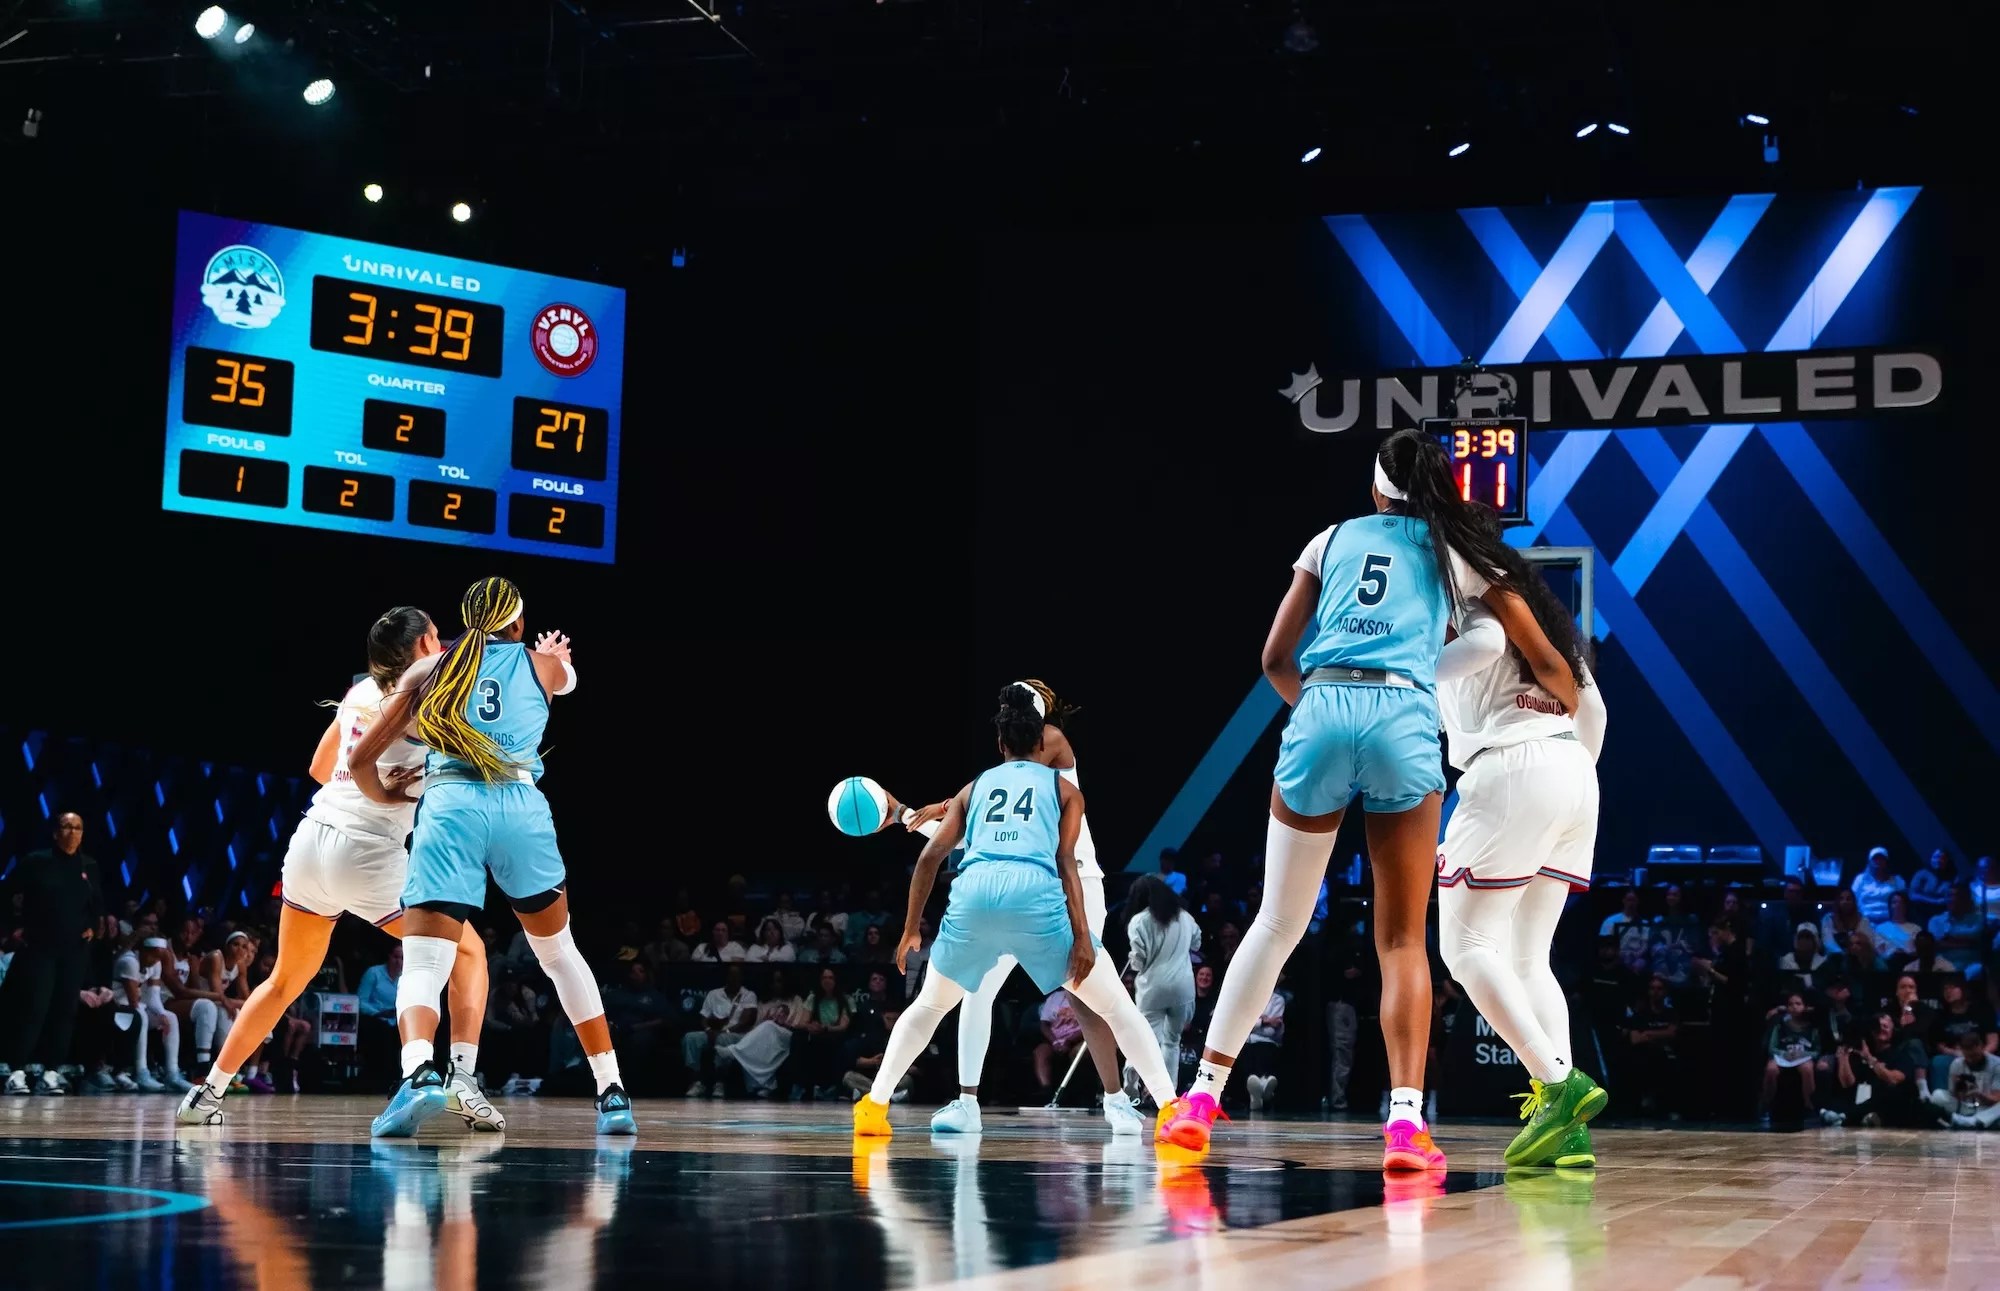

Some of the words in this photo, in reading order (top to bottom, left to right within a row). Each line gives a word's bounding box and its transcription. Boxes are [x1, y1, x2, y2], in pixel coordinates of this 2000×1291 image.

[223, 254, 267, 272] MIST
[342, 254, 481, 292] UNRIVALED
[343, 292, 474, 361] 3:39
[538, 308, 589, 337] VINYL
[211, 359, 266, 407] 35
[367, 373, 446, 395] QUARTER
[1279, 352, 1943, 433] UNRIVALED
[207, 433, 266, 451] FOULS
[395, 414, 414, 442] 2
[536, 408, 586, 453] 27
[1454, 429, 1515, 458] 3:39
[334, 450, 367, 466] TOL
[236, 466, 245, 493] 1
[438, 465, 471, 480] TOL
[340, 479, 359, 507] 2
[533, 478, 584, 496] FOULS
[443, 493, 462, 520] 2
[548, 506, 566, 534] 2
[1356, 552, 1393, 607] 5
[1334, 617, 1394, 636] JACKSON
[477, 678, 503, 723] 3
[984, 786, 1036, 825] 24
[994, 830, 1019, 842] LOYD
